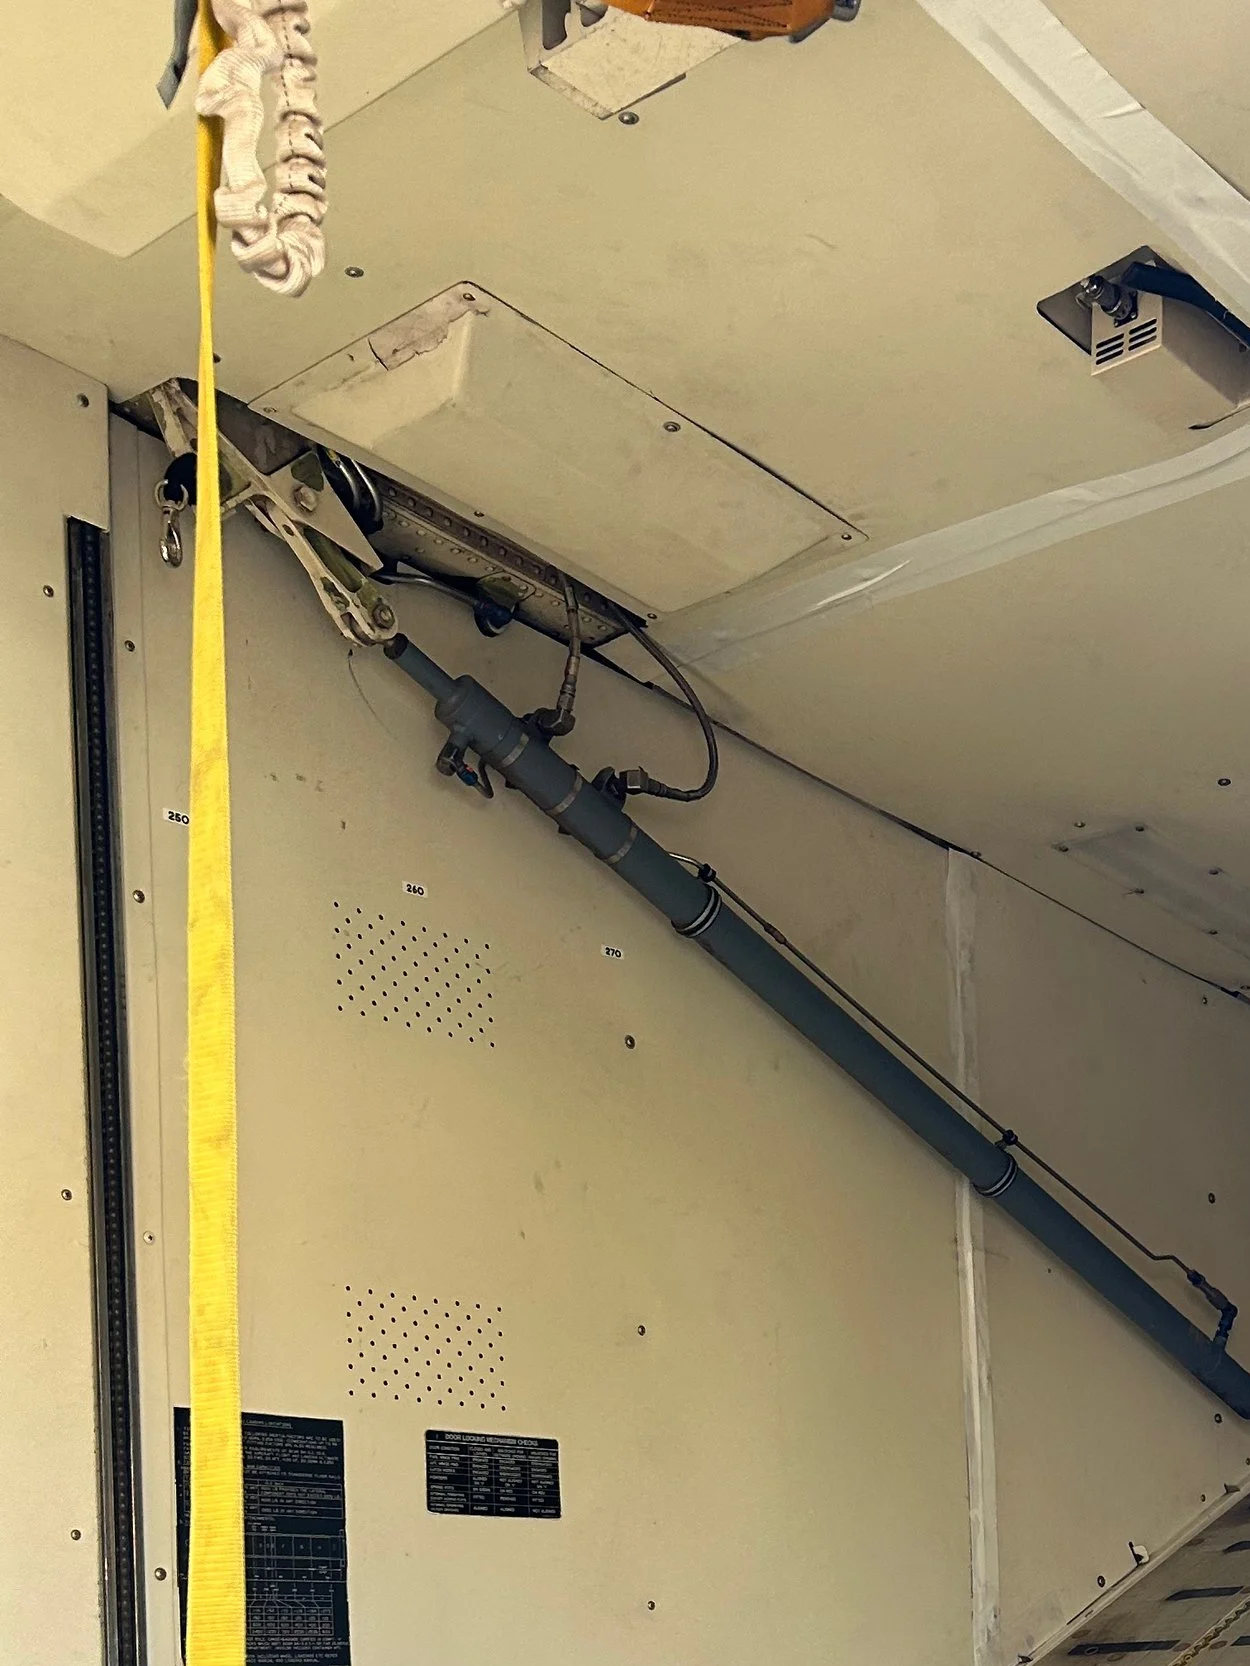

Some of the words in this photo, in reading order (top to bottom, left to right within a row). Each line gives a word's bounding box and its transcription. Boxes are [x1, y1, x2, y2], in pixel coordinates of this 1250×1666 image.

[168, 811, 189, 825] 250
[405, 883, 425, 897] 260
[604, 946, 622, 959] 270
